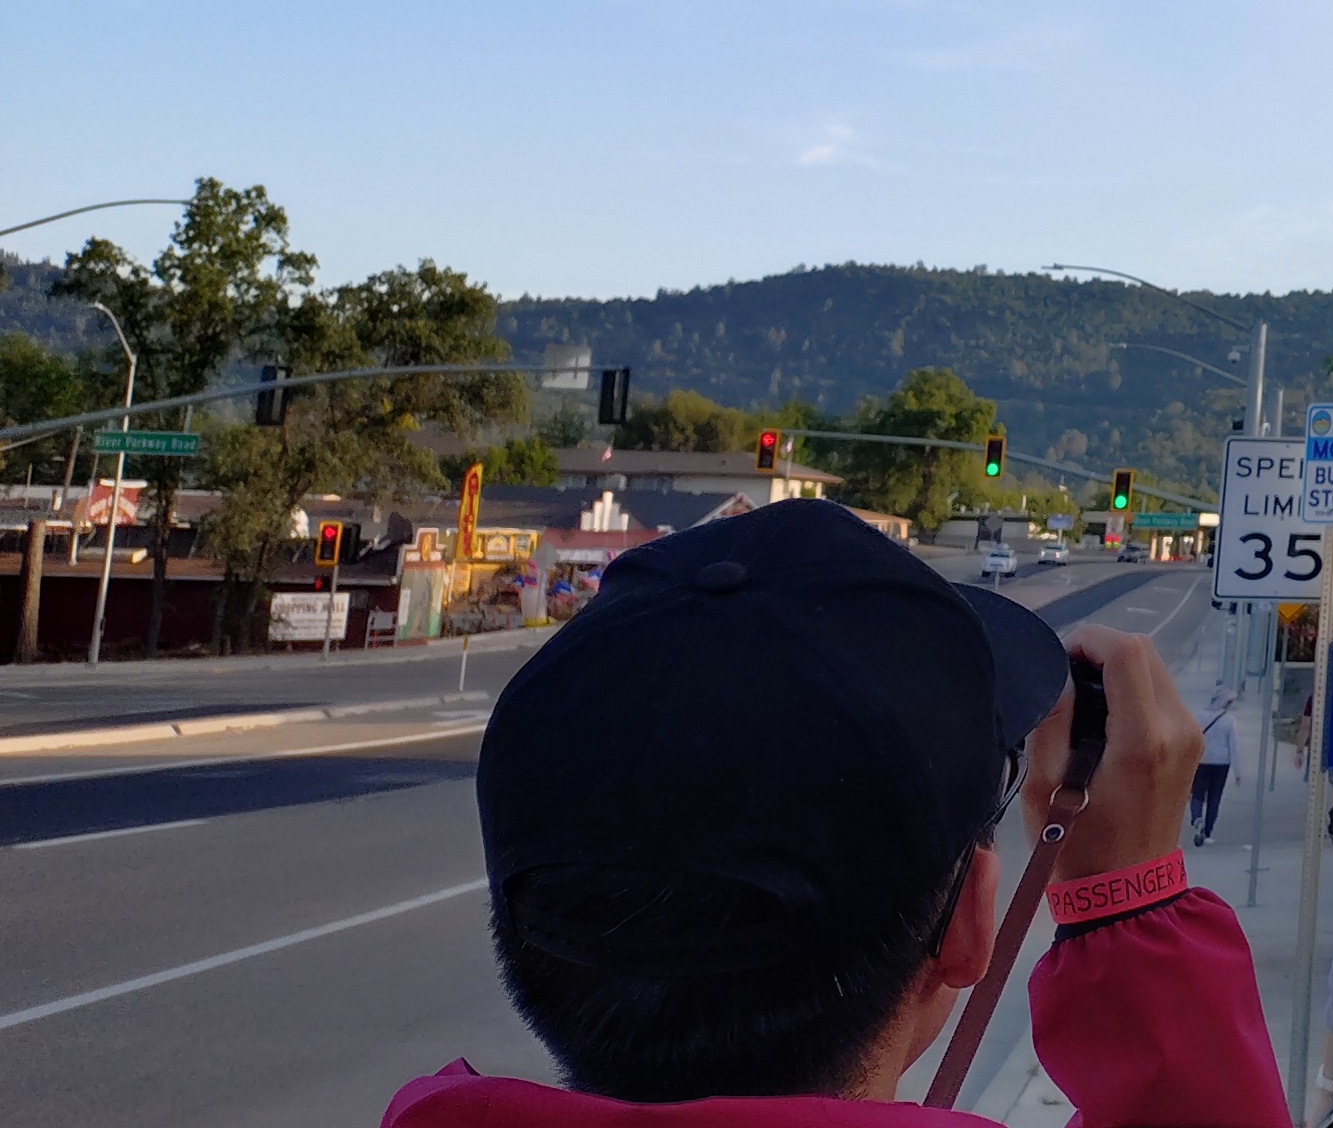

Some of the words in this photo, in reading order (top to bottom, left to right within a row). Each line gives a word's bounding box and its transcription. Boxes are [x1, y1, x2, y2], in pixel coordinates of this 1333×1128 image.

[1236, 457, 1304, 480] SPE
[1244, 493, 1302, 517] LIMI
[1234, 532, 1323, 582] 35
[1051, 862, 1175, 916] PASSENGER
